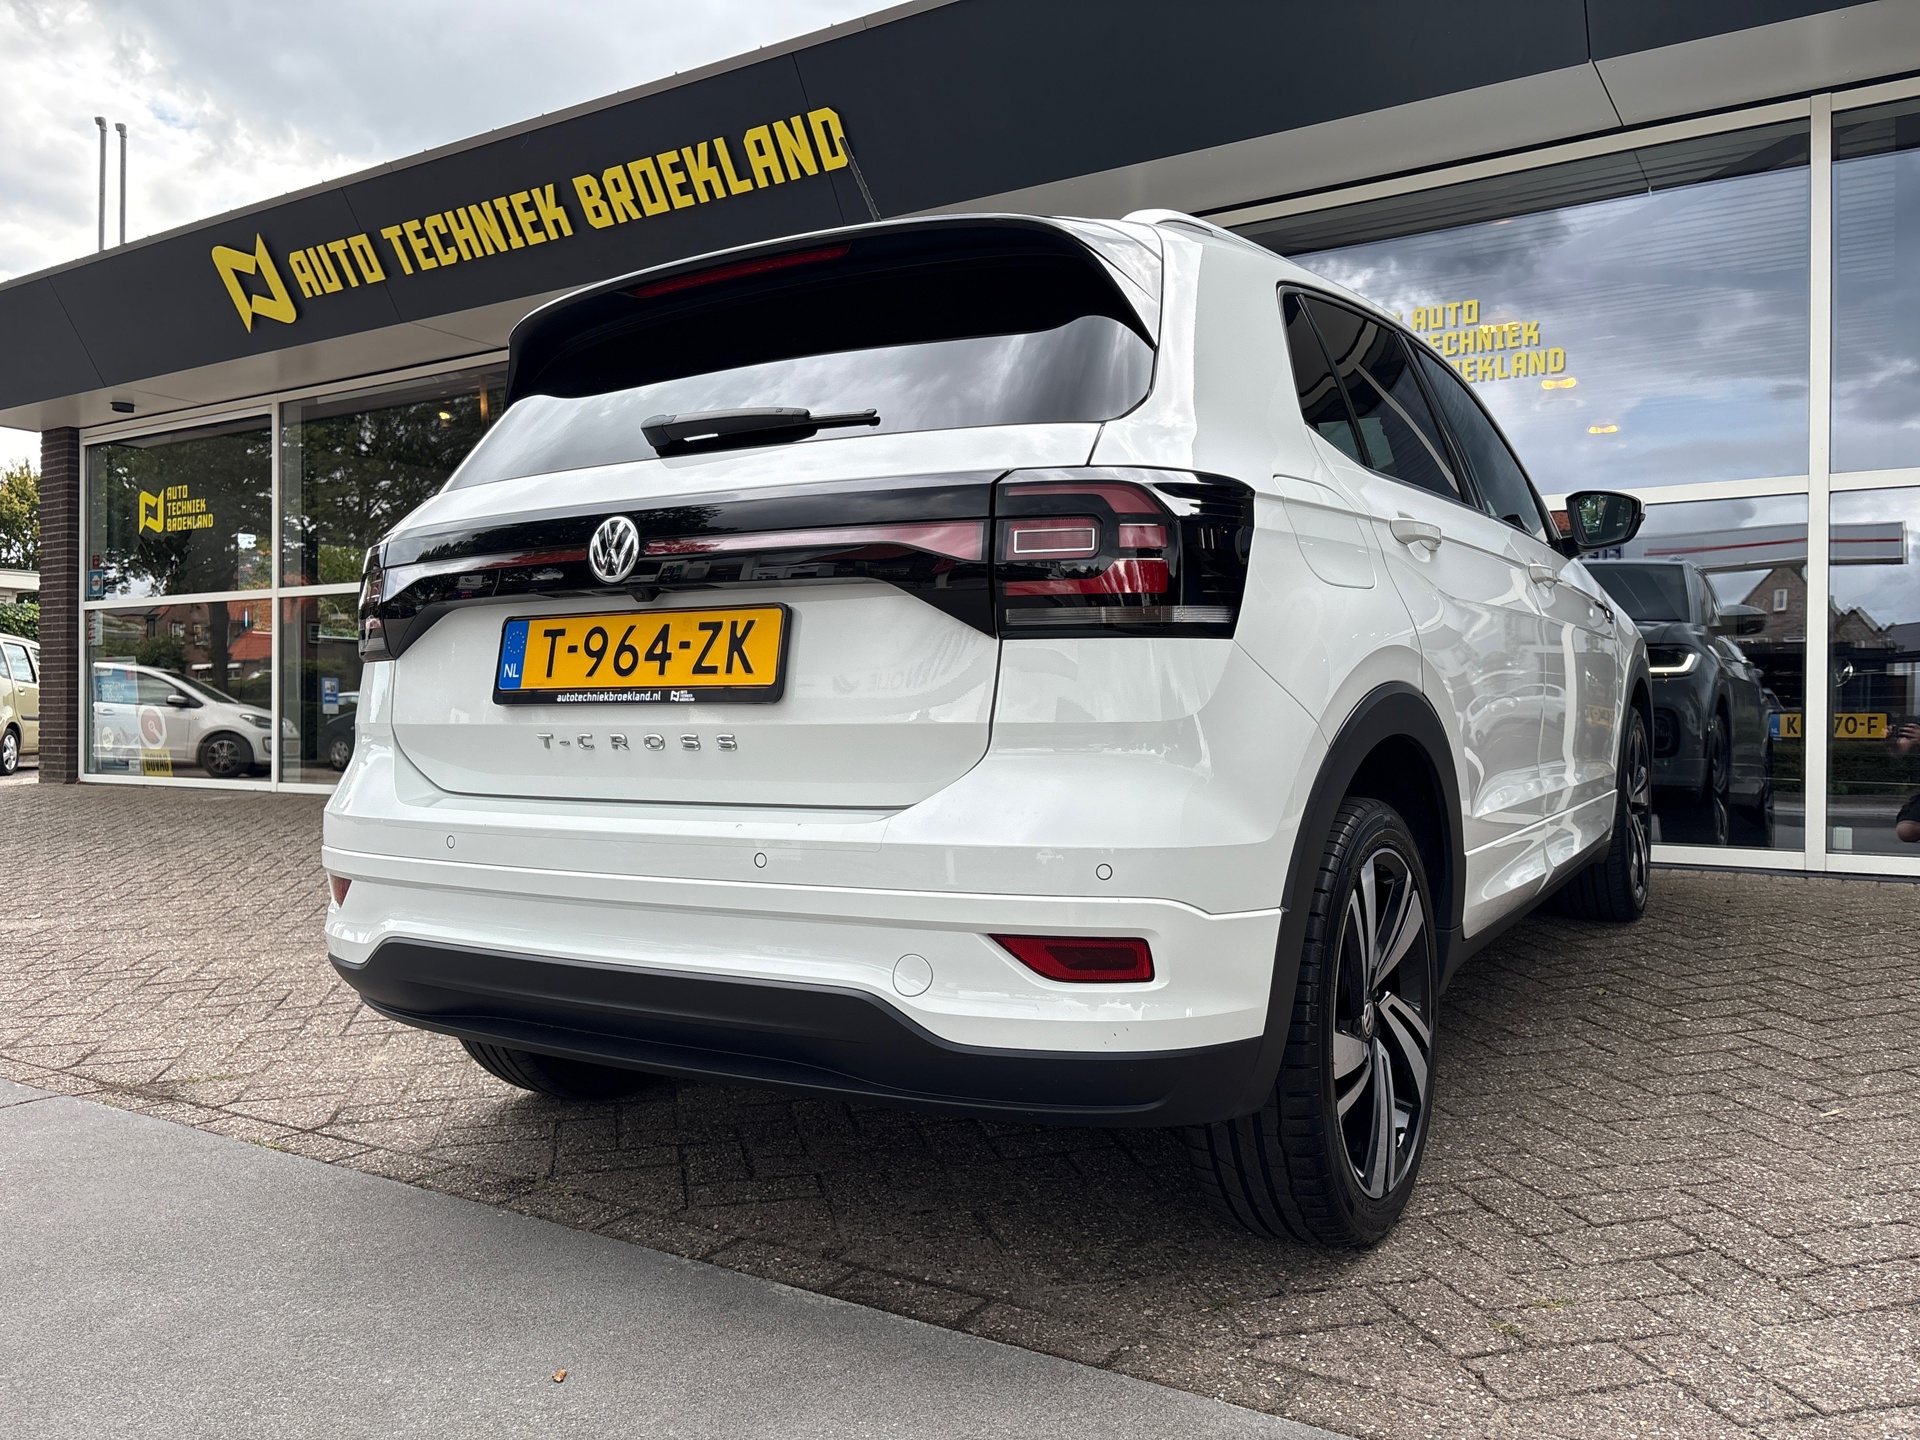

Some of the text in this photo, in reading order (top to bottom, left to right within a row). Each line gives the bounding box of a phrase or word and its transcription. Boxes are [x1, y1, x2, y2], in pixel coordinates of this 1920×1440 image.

[288, 107, 849, 297] AUTO TECHNIEK BROEKLAND
[1412, 299, 1479, 331] AUTO
[1421, 320, 1539, 356] ECHNIEK
[1451, 347, 1565, 382] EKLAND
[166, 484, 188, 500] AUTO
[166, 497, 206, 516] TECHNIEK
[166, 513, 214, 532] BROEKLAND
[542, 619, 758, 679] T-964-ZK
[503, 663, 520, 678] NL
[556, 691, 662, 702] autotechniekbroekland.nl
[536, 732, 738, 752] T-CROSS
